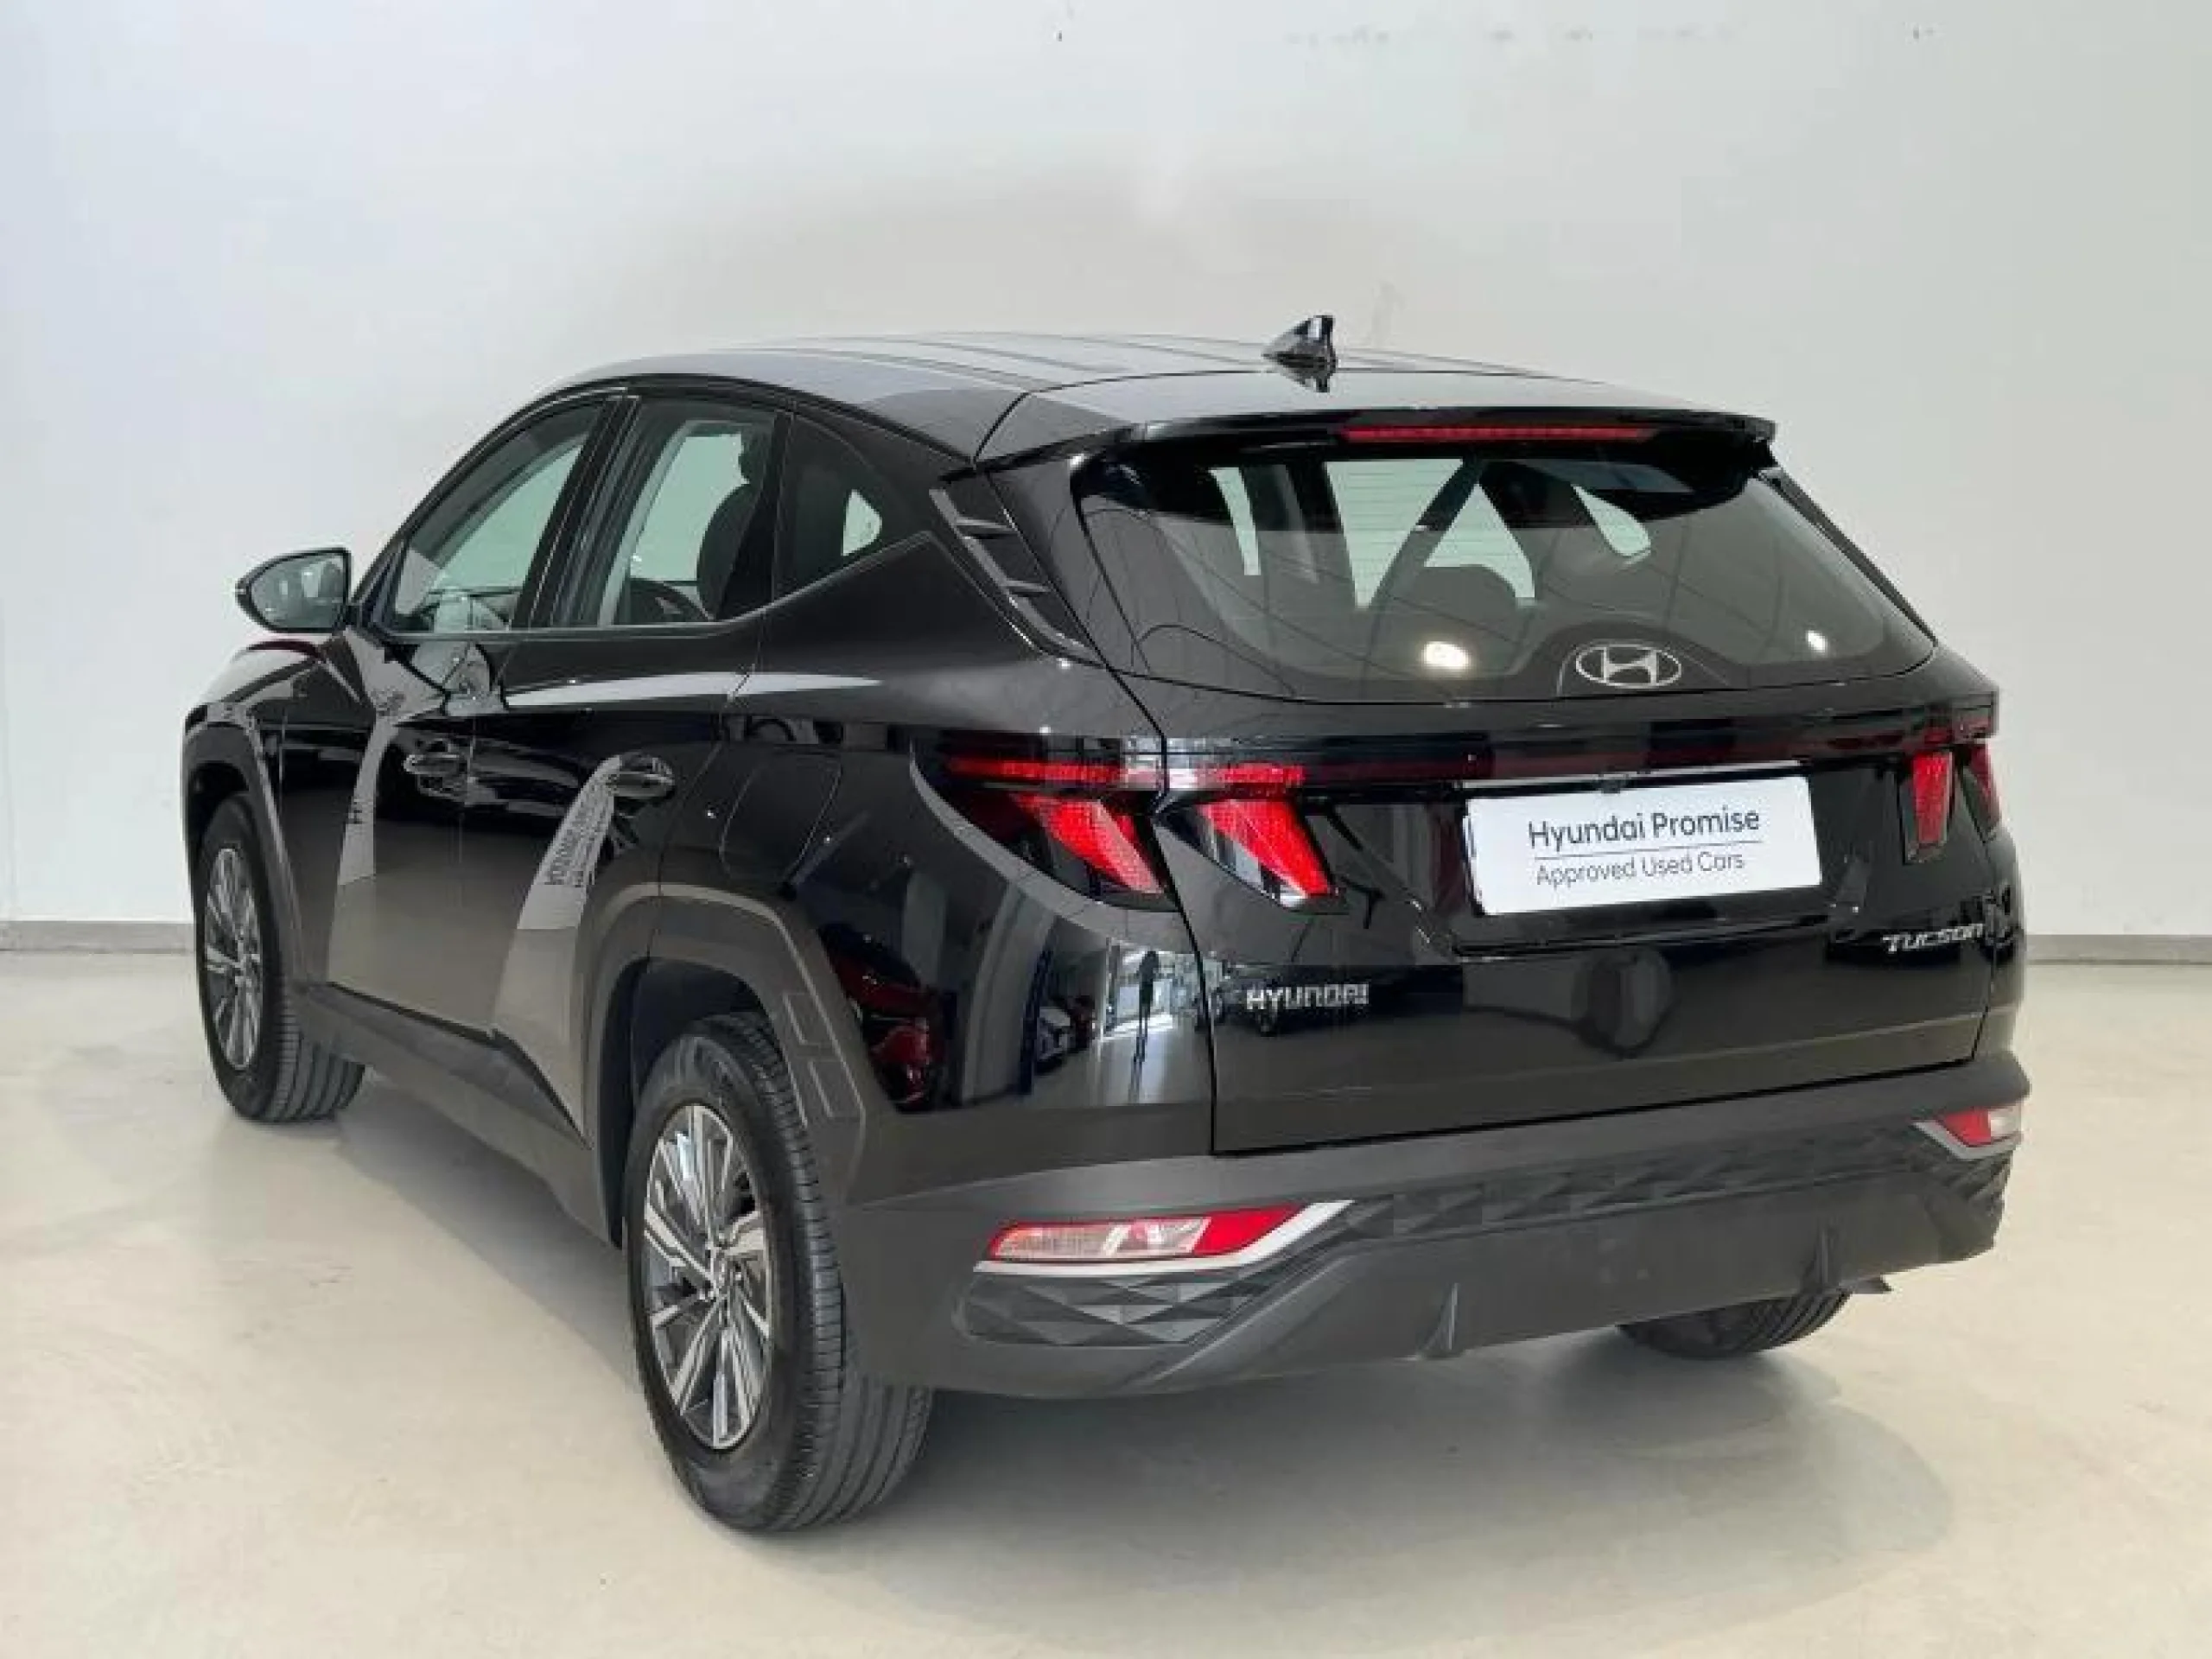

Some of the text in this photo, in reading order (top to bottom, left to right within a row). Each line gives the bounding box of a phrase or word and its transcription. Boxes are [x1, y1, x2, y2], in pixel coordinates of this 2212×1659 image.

[1529, 805, 1760, 852] Hyundai Promise
[1536, 850, 1745, 889] Approved Used Cars
[1246, 983, 1370, 1010] HYUNDAI
